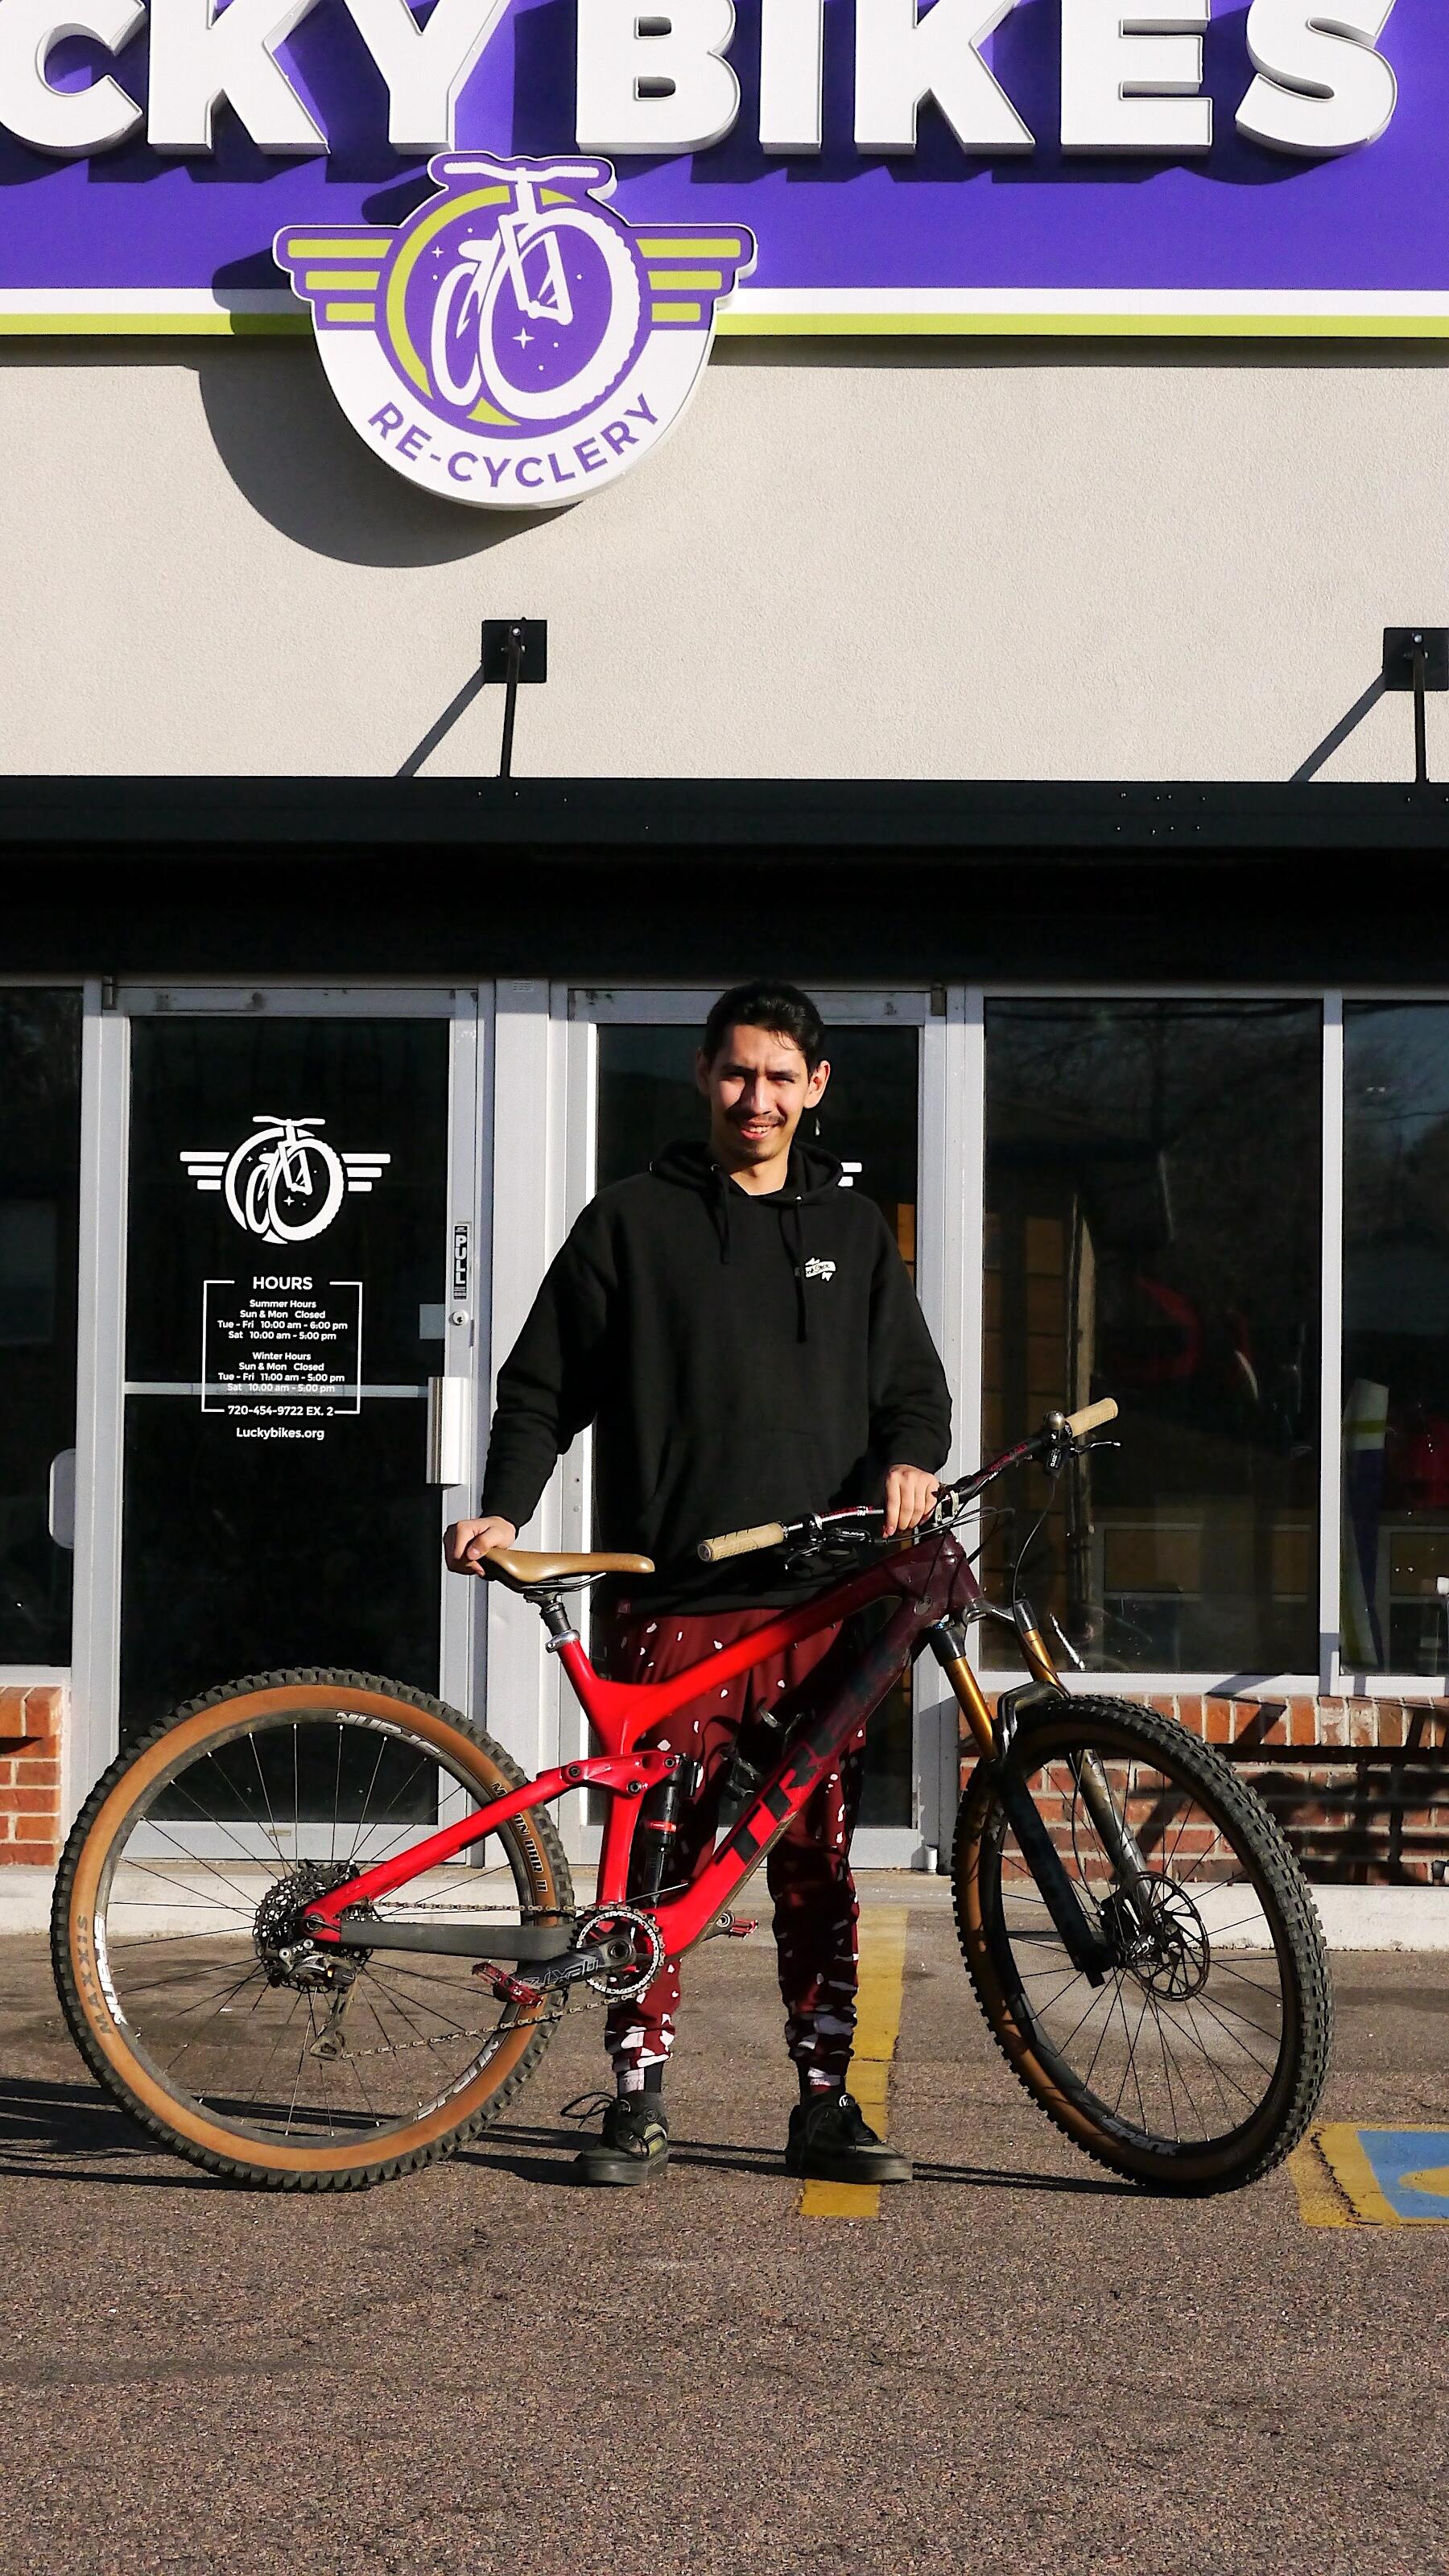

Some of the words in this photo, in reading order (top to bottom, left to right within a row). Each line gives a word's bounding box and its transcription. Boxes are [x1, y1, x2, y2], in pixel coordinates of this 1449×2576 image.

[576, 0, 1398, 155] BIKES
[368, 393, 658, 487] RE-CYCLERY
[455, 1235, 467, 1285] PULL
[254, 1277, 312, 1290] HOURS
[250, 1299, 288, 1307] Summer
[290, 1300, 316, 1308] Hours
[240, 1310, 257, 1318] Sun
[295, 1311, 325, 1319] Closed
[217, 1320, 234, 1328] Tue
[242, 1320, 254, 1328] Fri
[229, 1331, 243, 1339] Sat
[299, 1331, 319, 1340] 5:00
[253, 1352, 283, 1360] Winter
[239, 1362, 256, 1370] Sun
[294, 1363, 324, 1371] Closed
[243, 1373, 254, 1381] Fri
[308, 1373, 328, 1381] 5:00
[227, 1383, 242, 1391] Sat
[298, 1384, 318, 1392] 5:00
[320, 1385, 335, 1393] pm
[228, 1406, 303, 1415] 720-454-9722
[307, 1406, 324, 1415] EX.
[327, 1406, 333, 1416] 2
[237, 1427, 324, 1440] Luckybikes.org
[77, 1915, 113, 2034] MAXXIS
